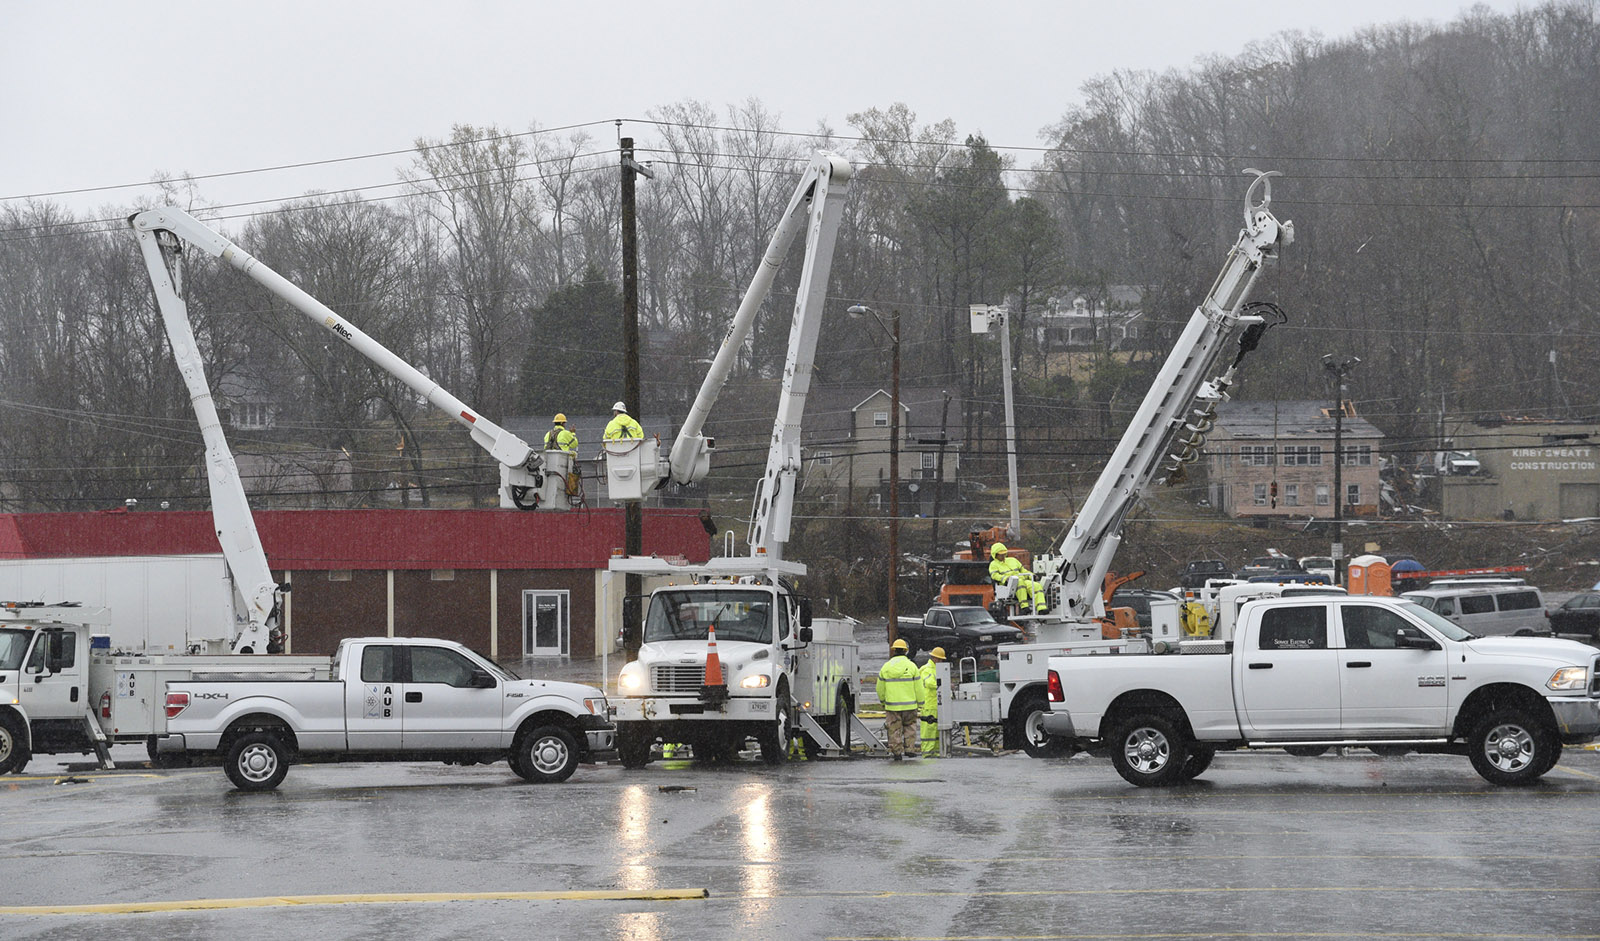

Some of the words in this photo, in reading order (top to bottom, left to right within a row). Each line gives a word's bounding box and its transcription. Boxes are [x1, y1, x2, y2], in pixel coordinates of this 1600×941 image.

[332, 323, 352, 340] Altec
[1512, 448, 1543, 457] KIRBY
[1545, 448, 1591, 457] SWEATT
[1510, 462, 1596, 470] CONSTRUCTION
